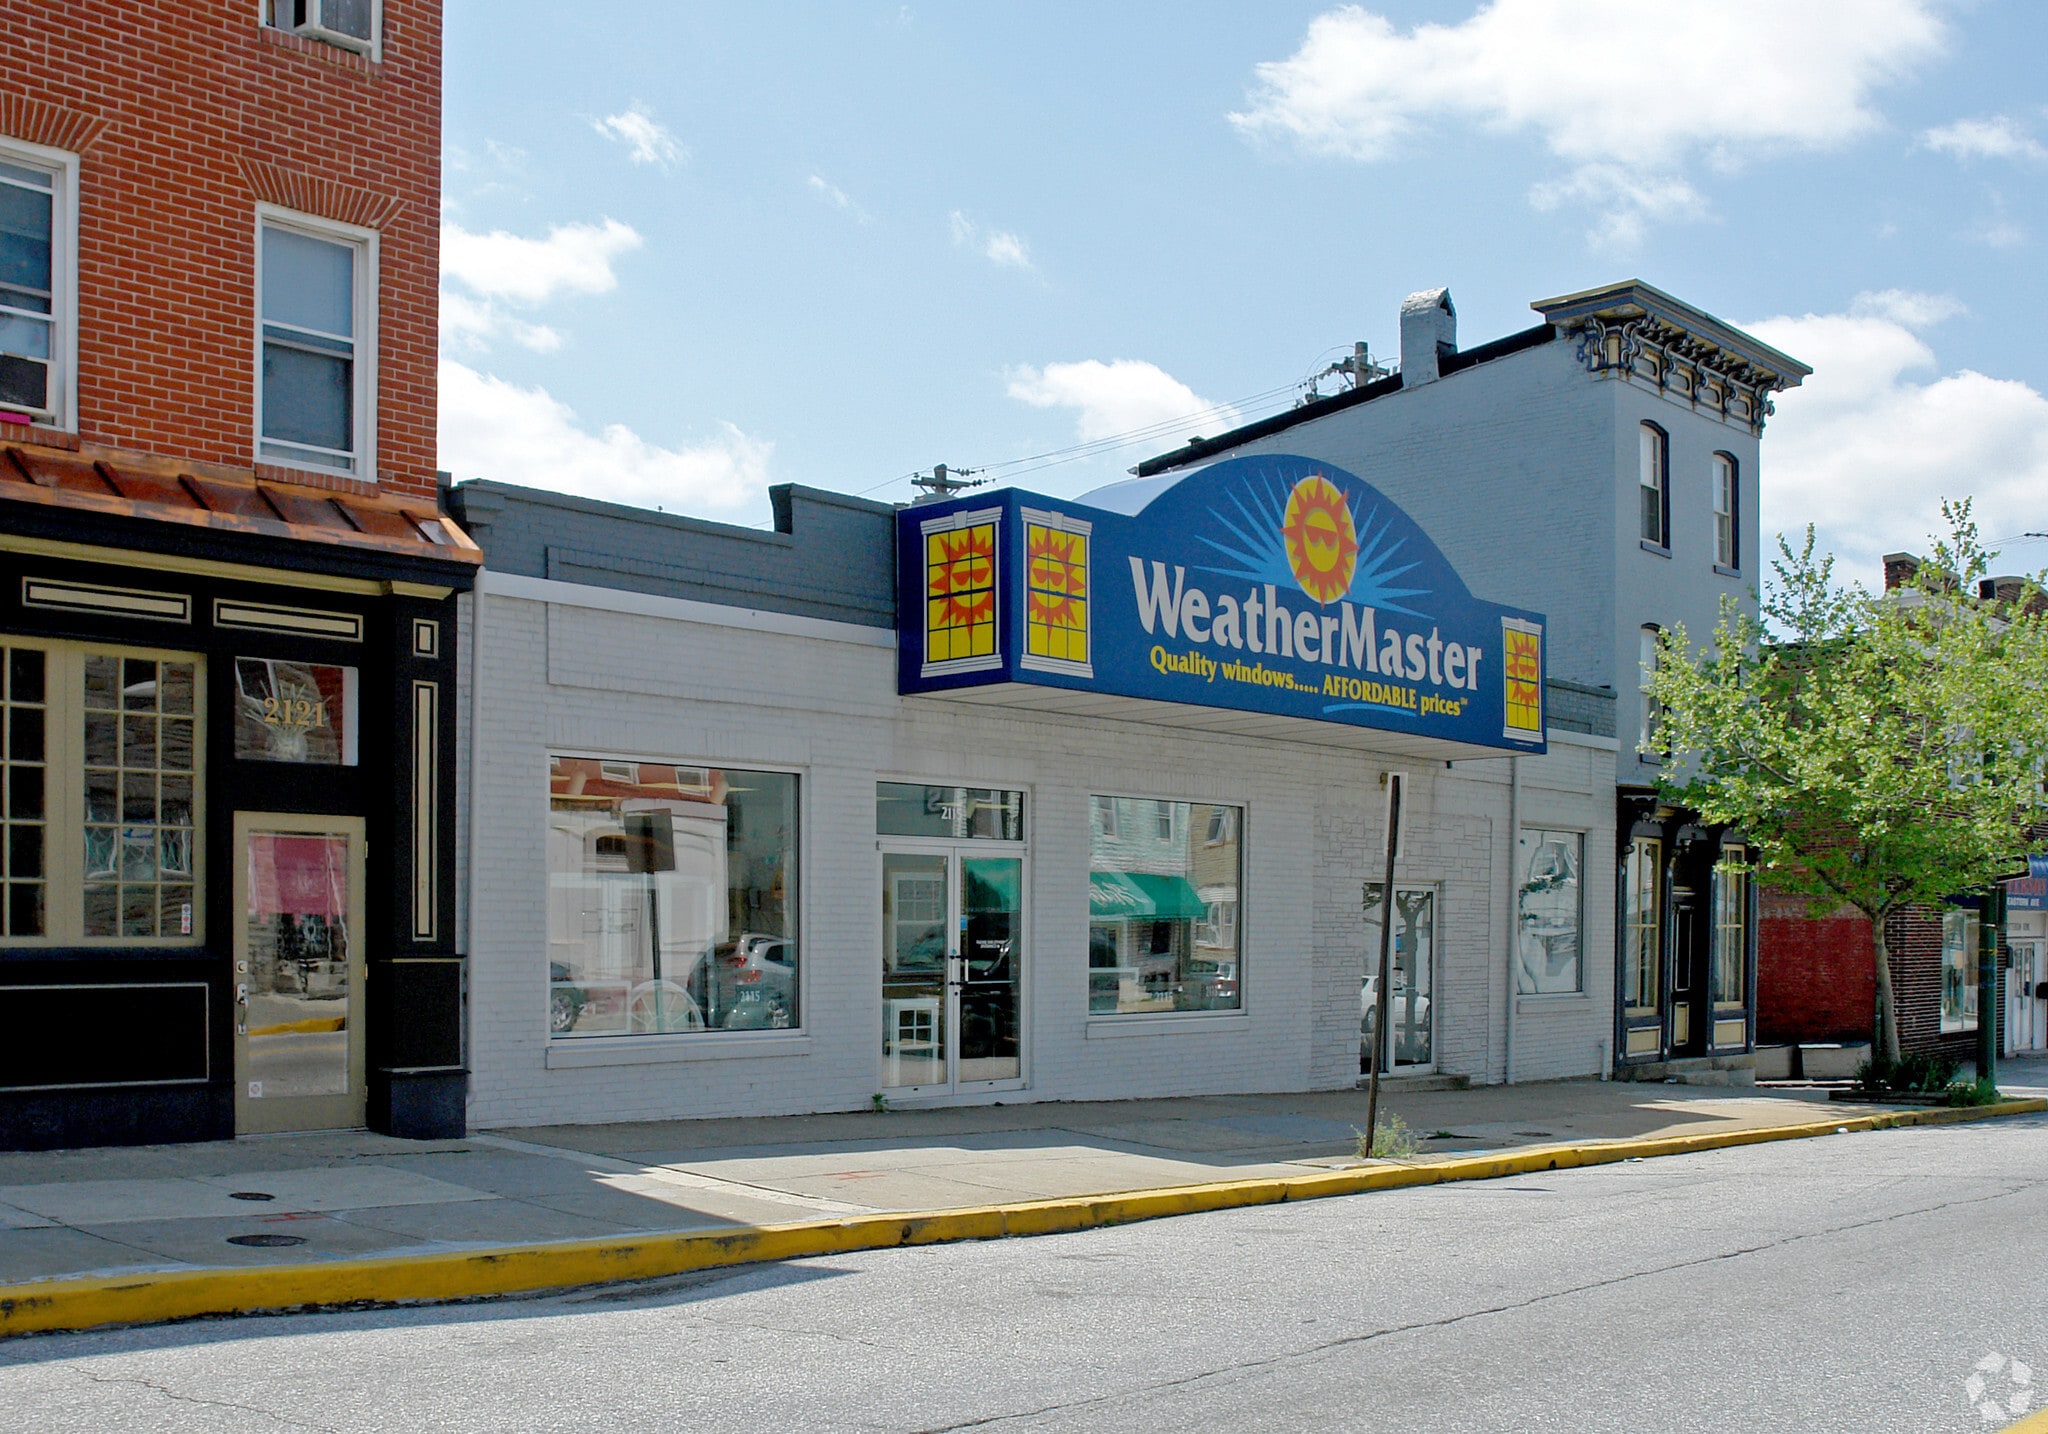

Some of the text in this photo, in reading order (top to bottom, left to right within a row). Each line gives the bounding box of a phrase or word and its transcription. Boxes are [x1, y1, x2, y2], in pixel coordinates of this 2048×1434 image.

[1128, 555, 1482, 690] WeatherMaster
[1150, 645, 1217, 683] Quality
[1322, 674, 1417, 709] AFFORDABLE
[263, 697, 324, 728] 2121
[740, 990, 760, 1002] 2115
